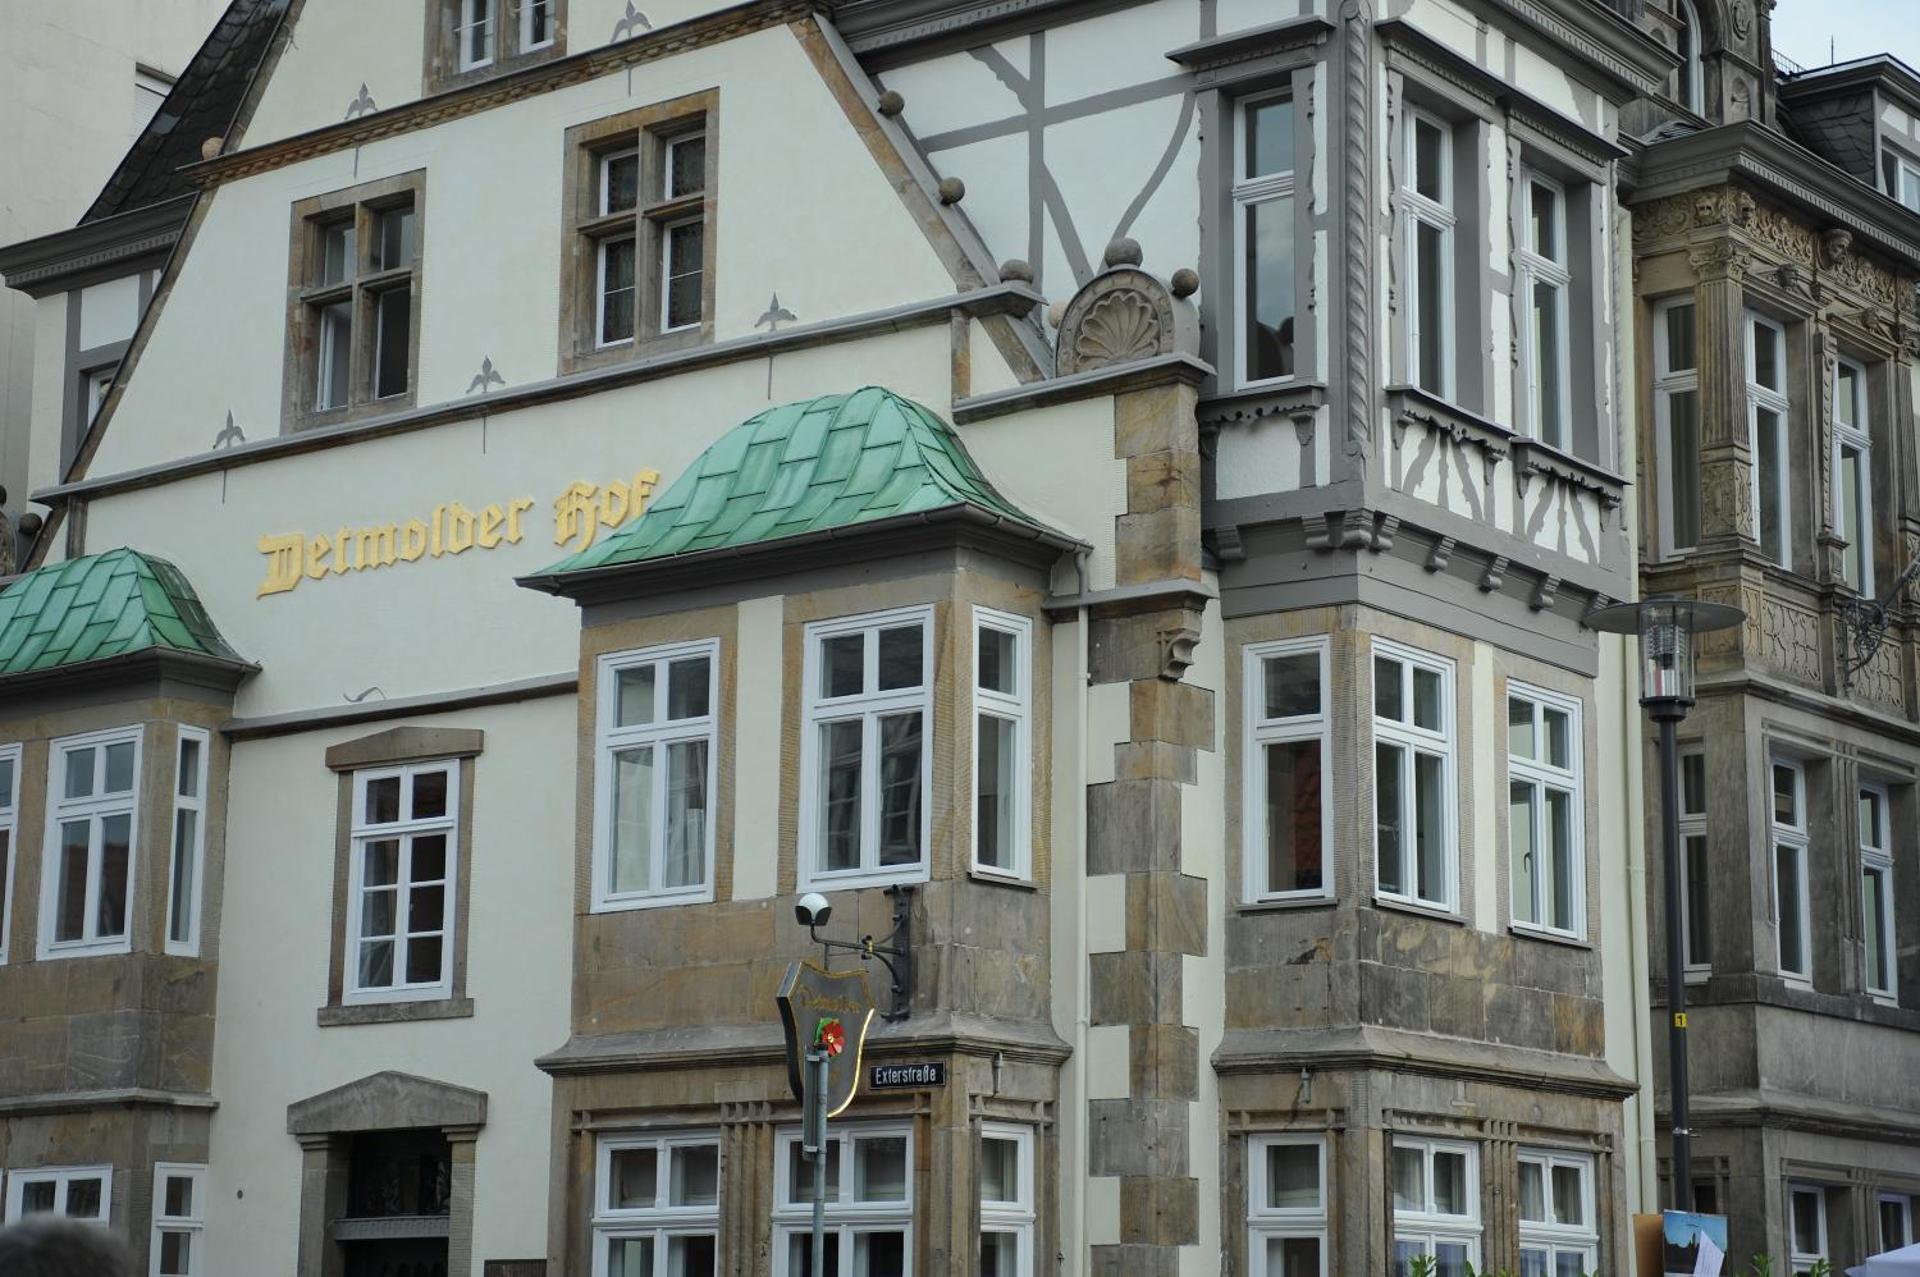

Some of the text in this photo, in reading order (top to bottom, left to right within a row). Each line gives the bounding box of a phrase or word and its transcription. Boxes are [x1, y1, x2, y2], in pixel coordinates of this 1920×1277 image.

[256, 470, 660, 600] Detmolder Hof
[875, 1064, 937, 1085] Exterstraße
